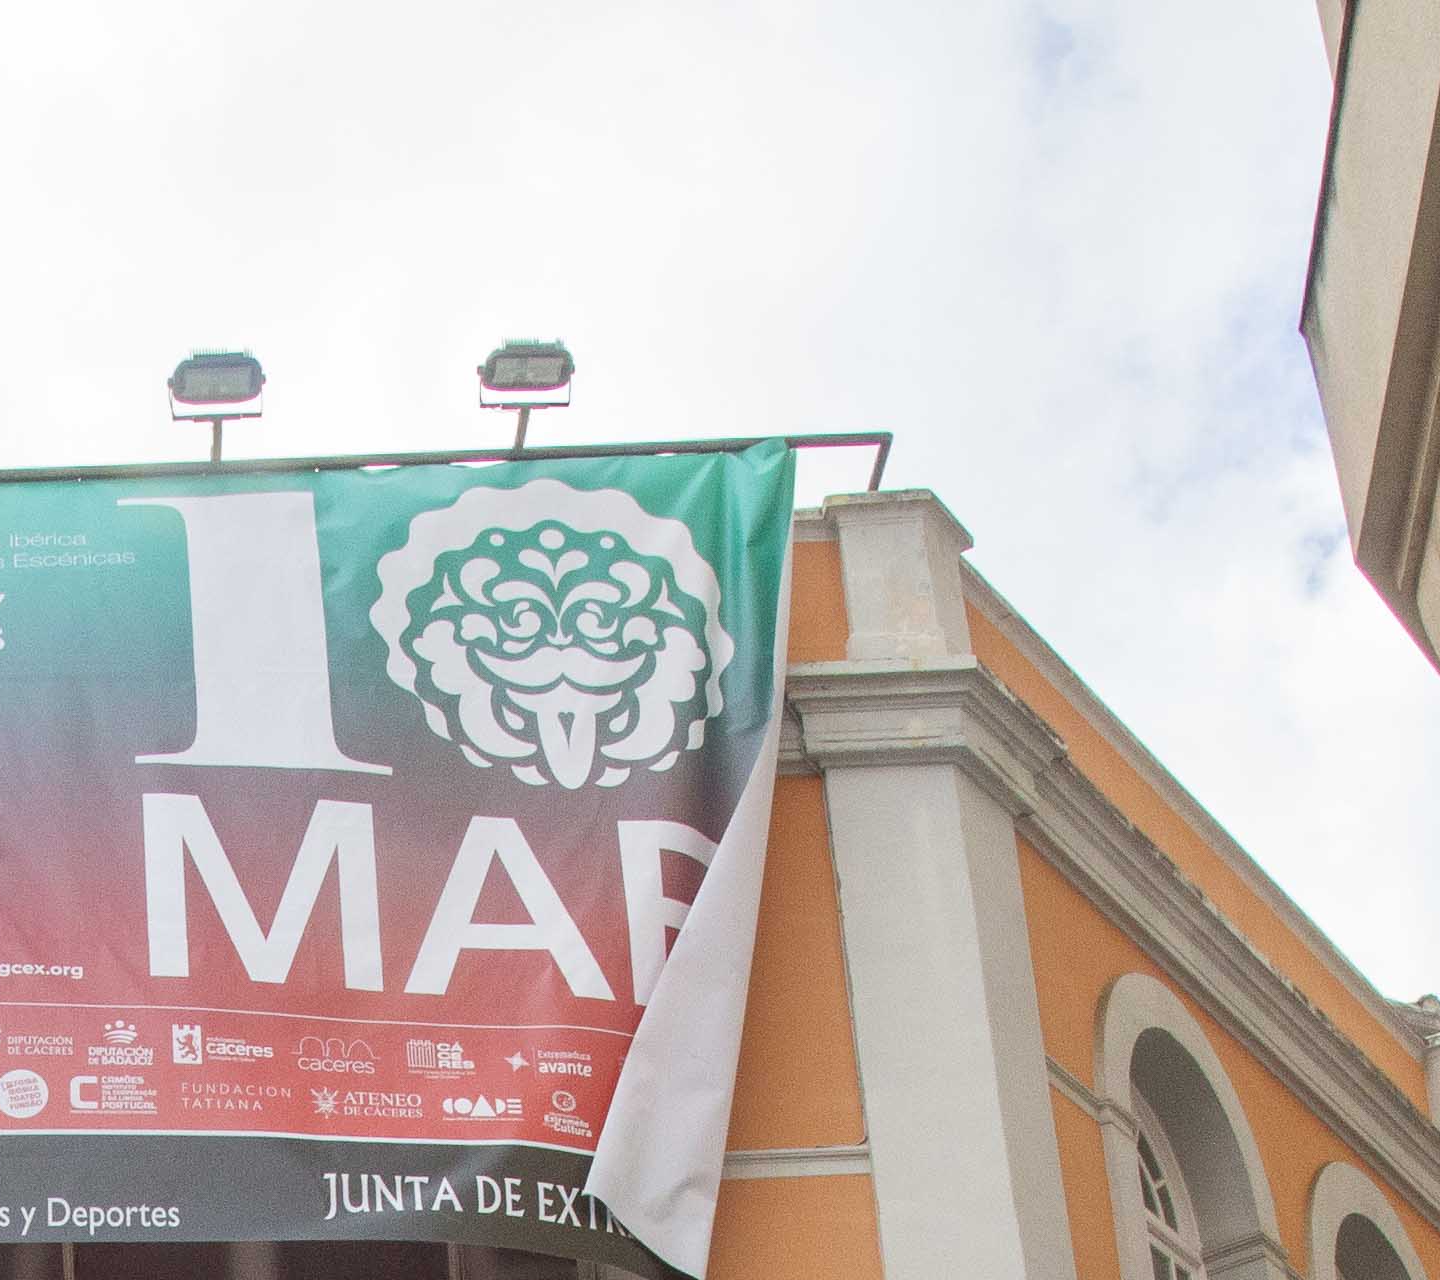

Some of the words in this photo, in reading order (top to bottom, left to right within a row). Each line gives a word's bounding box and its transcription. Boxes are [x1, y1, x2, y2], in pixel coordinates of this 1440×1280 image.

[10, 531, 88, 549] Ibérica
[13, 549, 137, 569] Escénicas
[7, 1035, 73, 1046] DIPUTACIÓN
[7, 1046, 22, 1055] DE
[88, 1045, 153, 1057] DIPUTACIÓN
[100, 1056, 153, 1066] BADAJOZ
[538, 1060, 593, 1078] avante
[181, 1098, 264, 1111] TATIANA
[343, 1091, 423, 1108] ATENEO
[344, 1106, 361, 1116] DE
[323, 1172, 464, 1221] JUNTA
[476, 1174, 525, 1218] DE
[20, 1206, 36, 1236] y
[47, 1197, 181, 1236] Deportes
